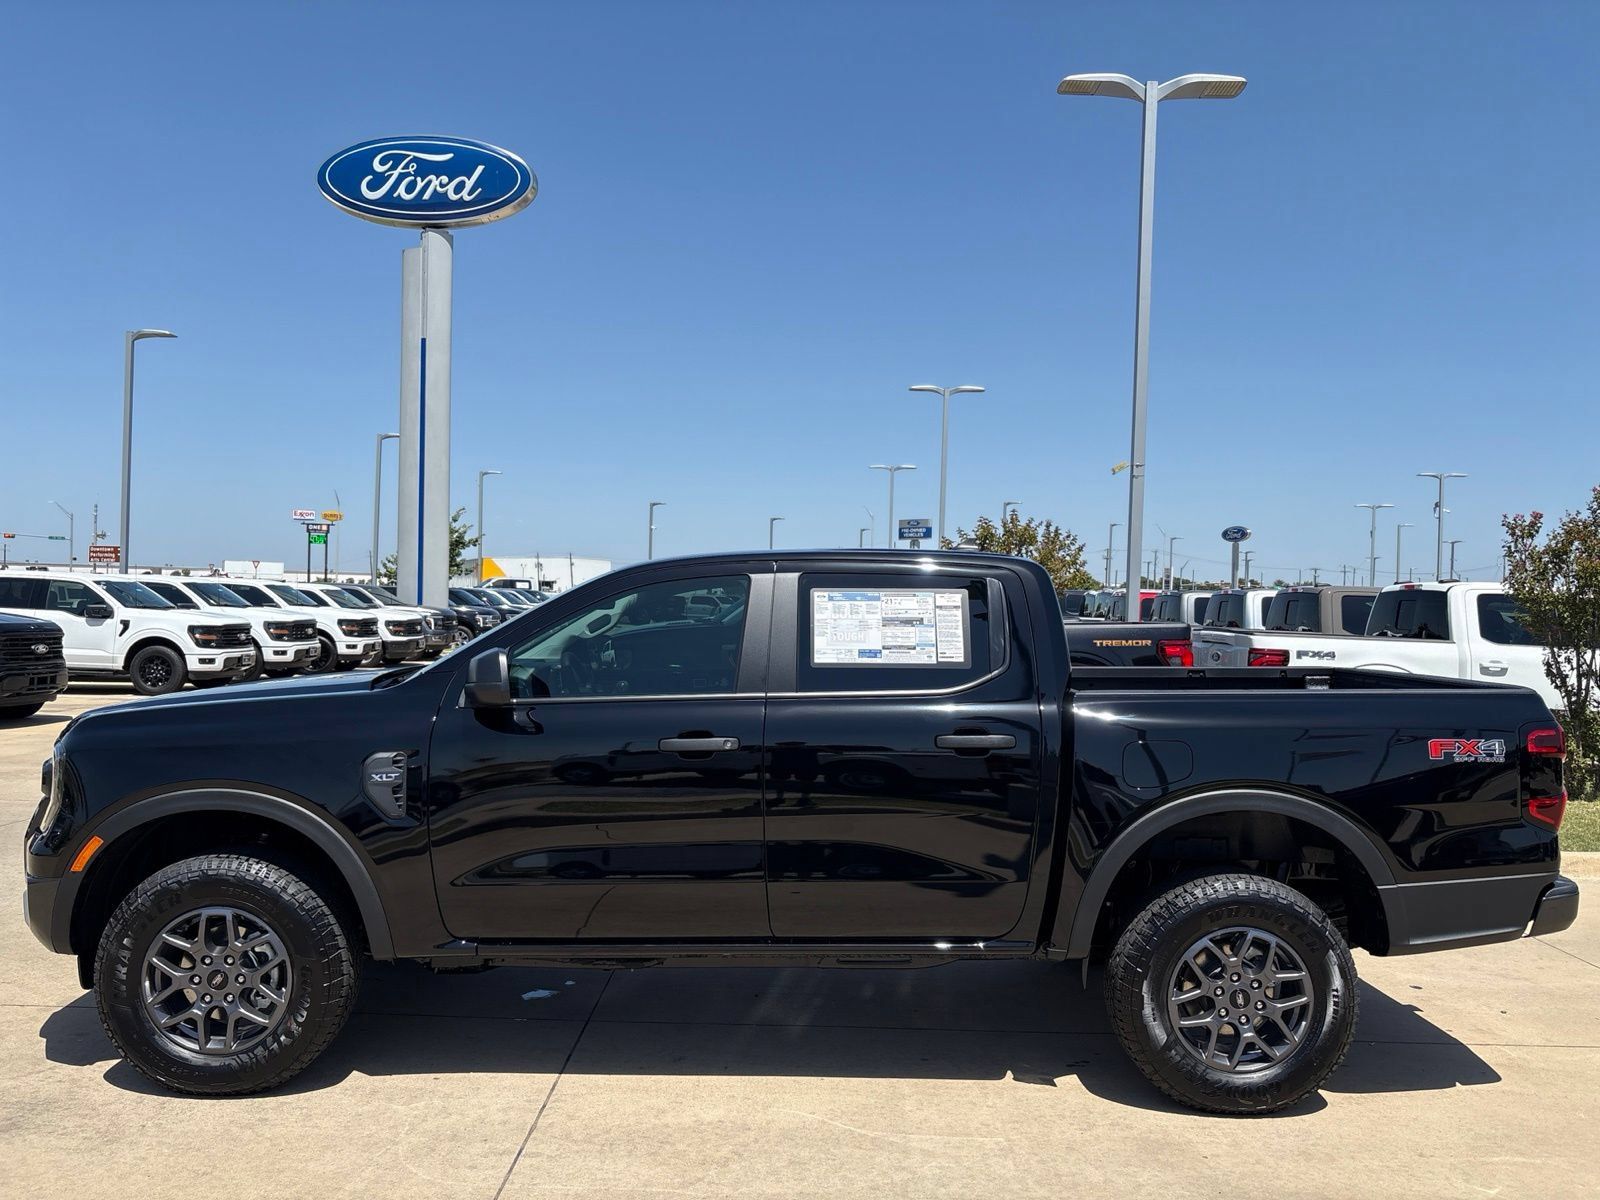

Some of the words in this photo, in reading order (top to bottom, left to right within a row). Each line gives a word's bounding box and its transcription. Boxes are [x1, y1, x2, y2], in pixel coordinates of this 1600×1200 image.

[360, 150, 485, 201] Ford
[293, 510, 315, 518] Exxon
[1093, 639, 1153, 647] TREMOR
[1296, 650, 1336, 660] FX4
[1428, 739, 1506, 760] FX4
[370, 773, 400, 781] XLT
[1207, 905, 1319, 954] WRANGLER
